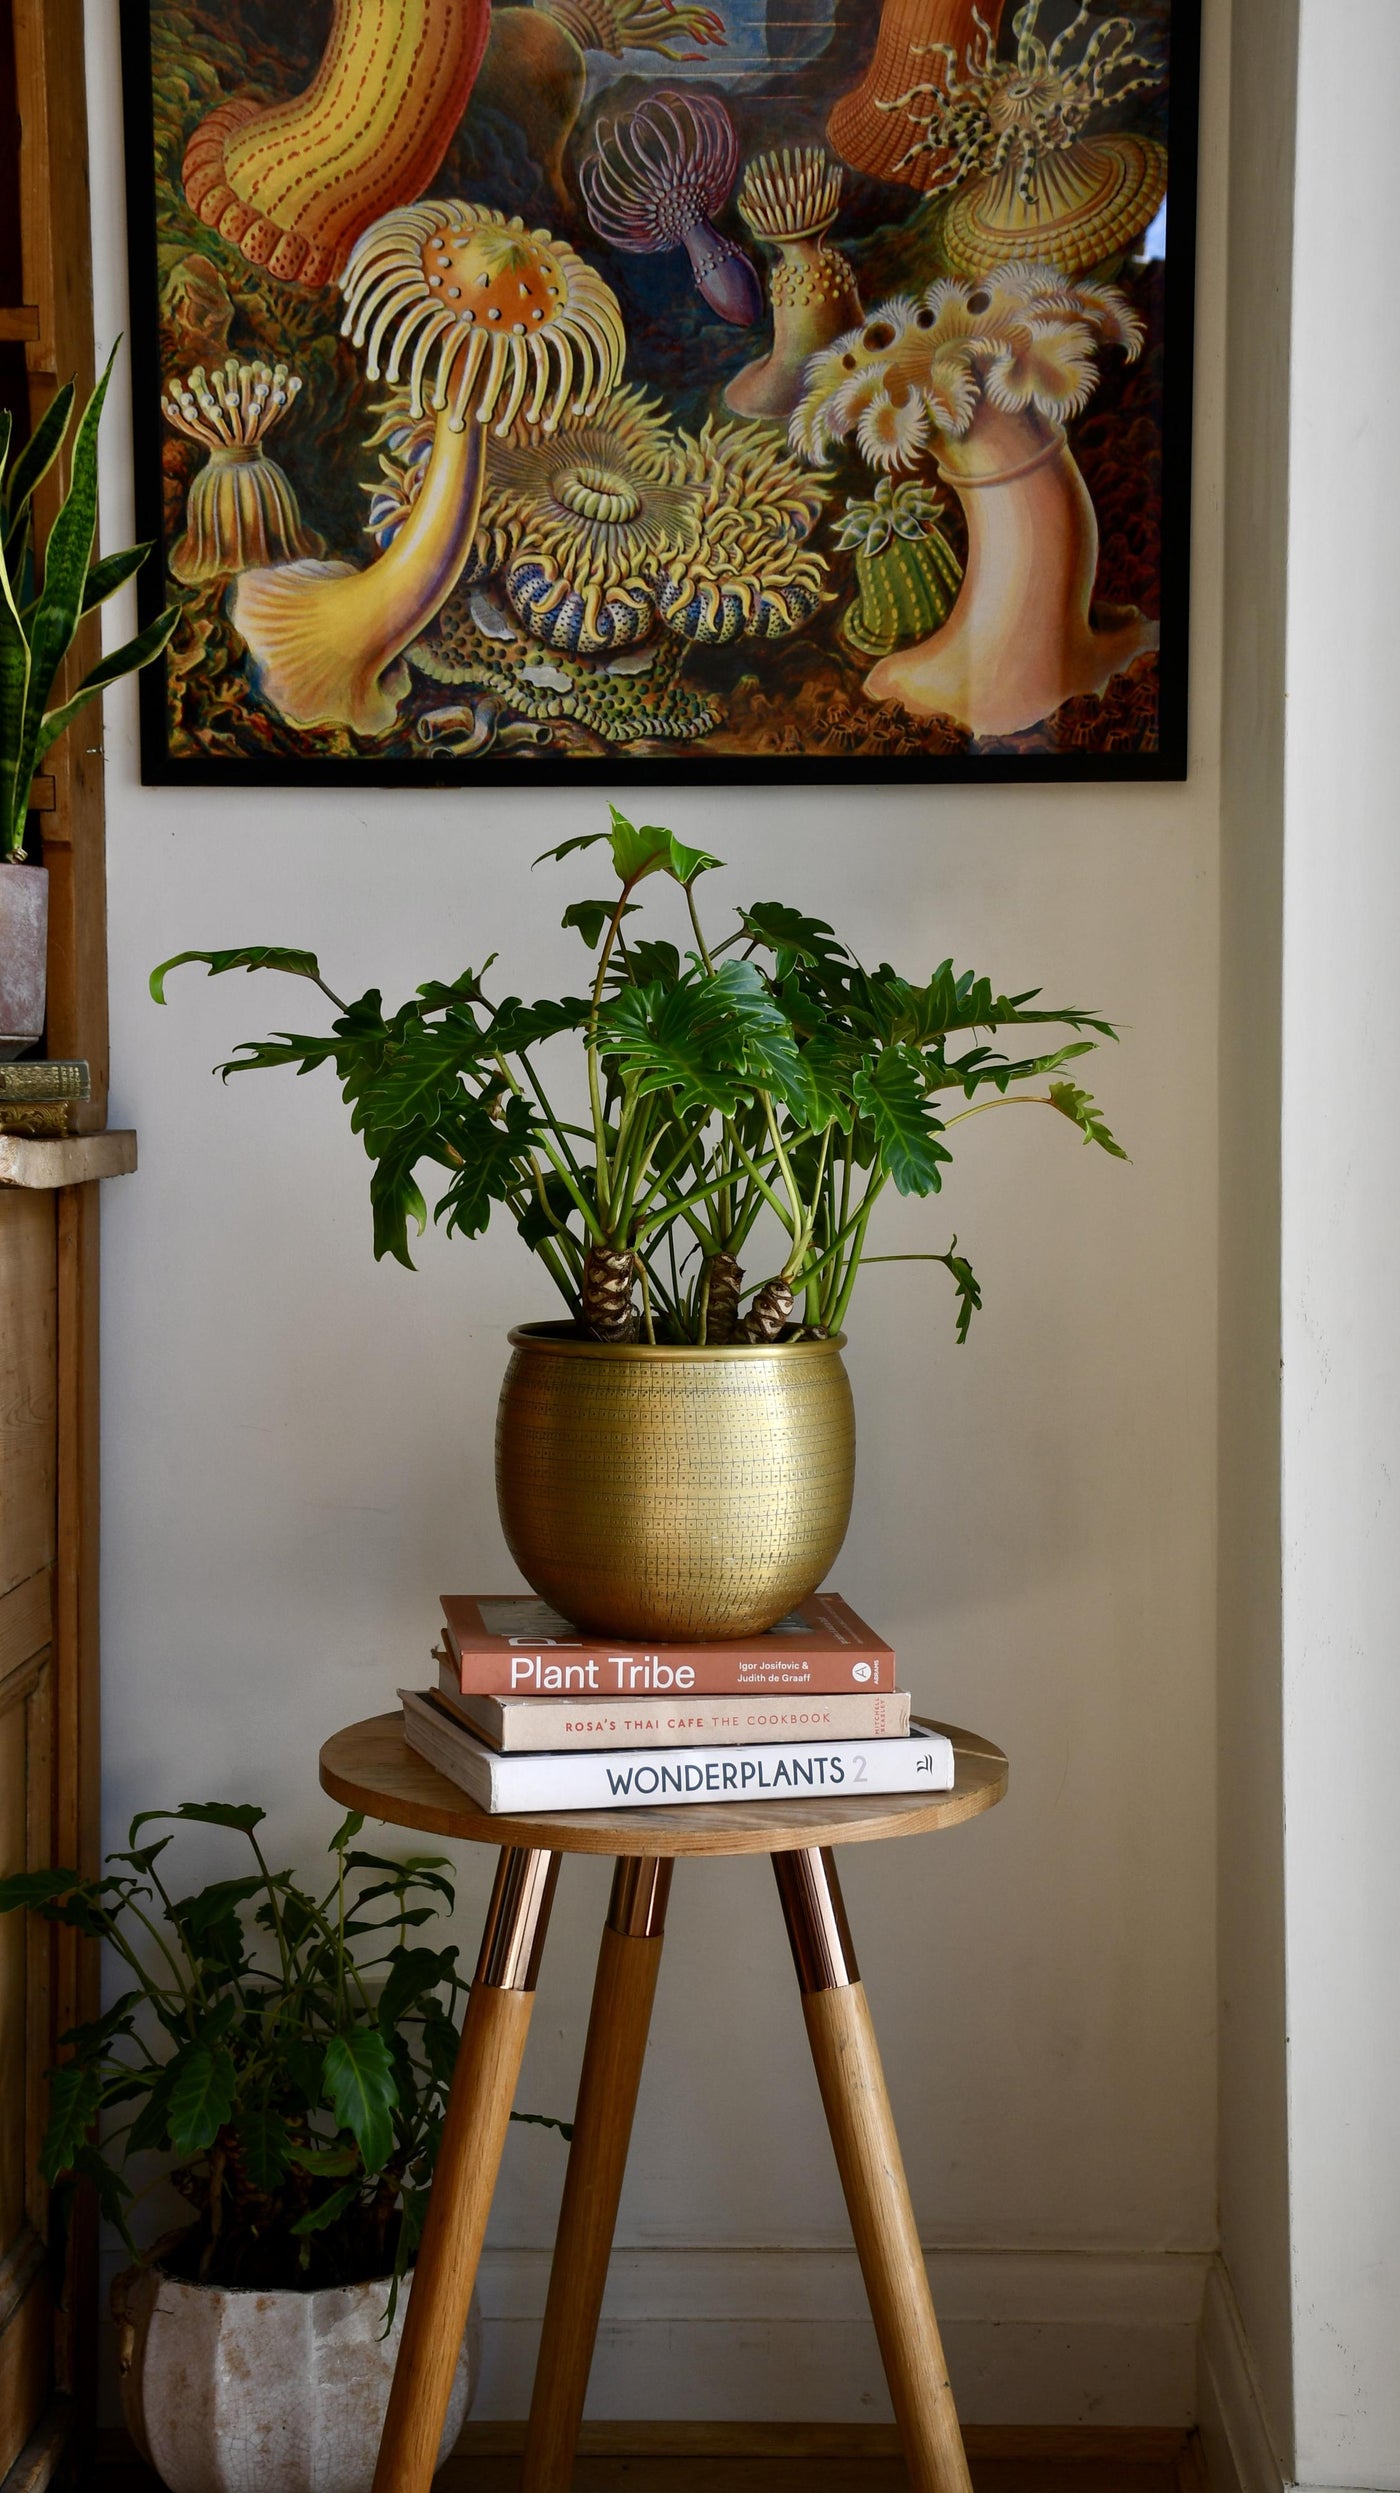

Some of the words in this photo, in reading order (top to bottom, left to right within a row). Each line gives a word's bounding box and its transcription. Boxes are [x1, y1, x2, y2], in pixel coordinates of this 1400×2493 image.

[511, 1656, 599, 1689] Plant
[608, 1656, 696, 1689] Tribe
[739, 1662, 757, 1672] Igor
[759, 1662, 800, 1670] Josifovic
[802, 1662, 809, 1670] &
[737, 1674, 766, 1682] Judith
[768, 1674, 780, 1682] de
[782, 1674, 811, 1682] Graaff
[565, 1718, 617, 1732] ROSA'S
[624, 1719, 660, 1731] THAI
[667, 1718, 704, 1729] CAFE
[712, 1716, 739, 1727] THE
[747, 1712, 831, 1726] COOKBOOK
[606, 1756, 845, 1796] WONDERPLANTS
[852, 1755, 868, 1783] 2
